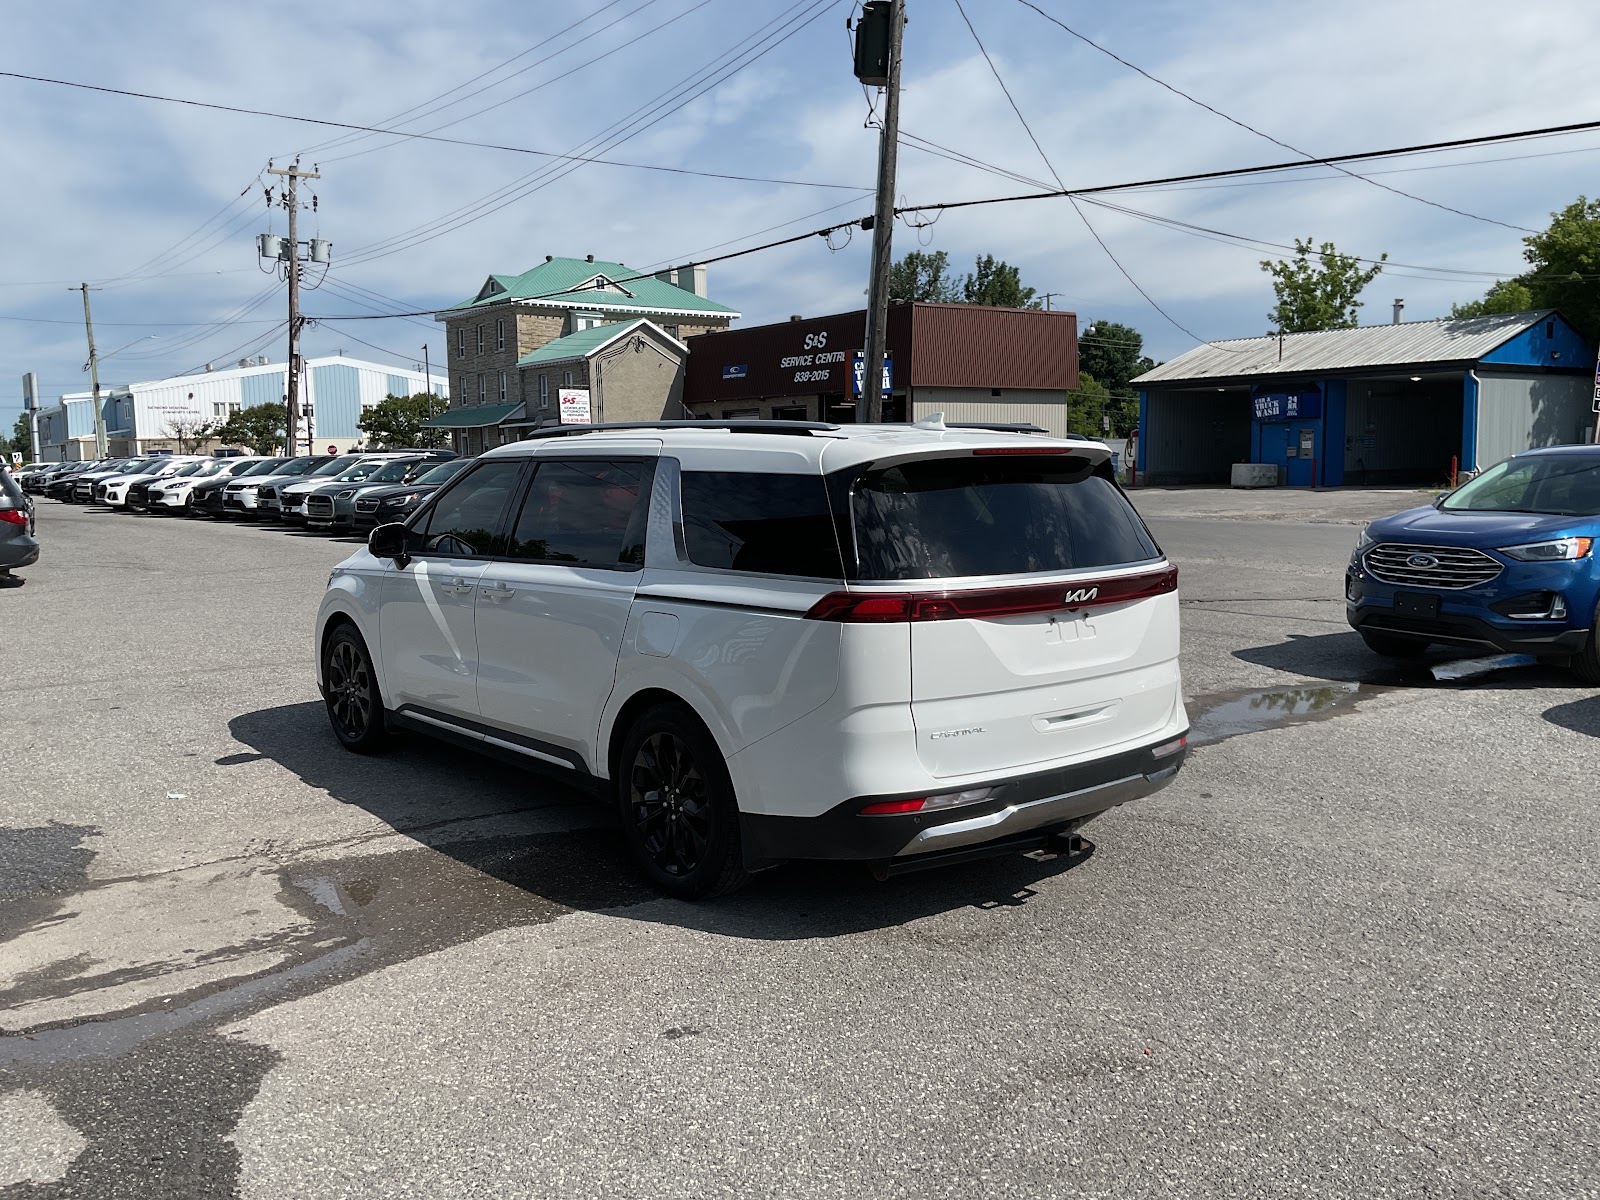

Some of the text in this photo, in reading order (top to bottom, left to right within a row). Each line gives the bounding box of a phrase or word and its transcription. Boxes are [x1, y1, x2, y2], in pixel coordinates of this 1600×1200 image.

[804, 331, 827, 350] S&S
[780, 355, 814, 368] SERVICE
[794, 369, 830, 383] 838-2015
[1254, 397, 1266, 405] CAR
[1255, 400, 1280, 411] TRUCK
[1287, 395, 1298, 404] 24
[1255, 406, 1280, 418] WASH
[930, 727, 987, 740] CARNIVAL
